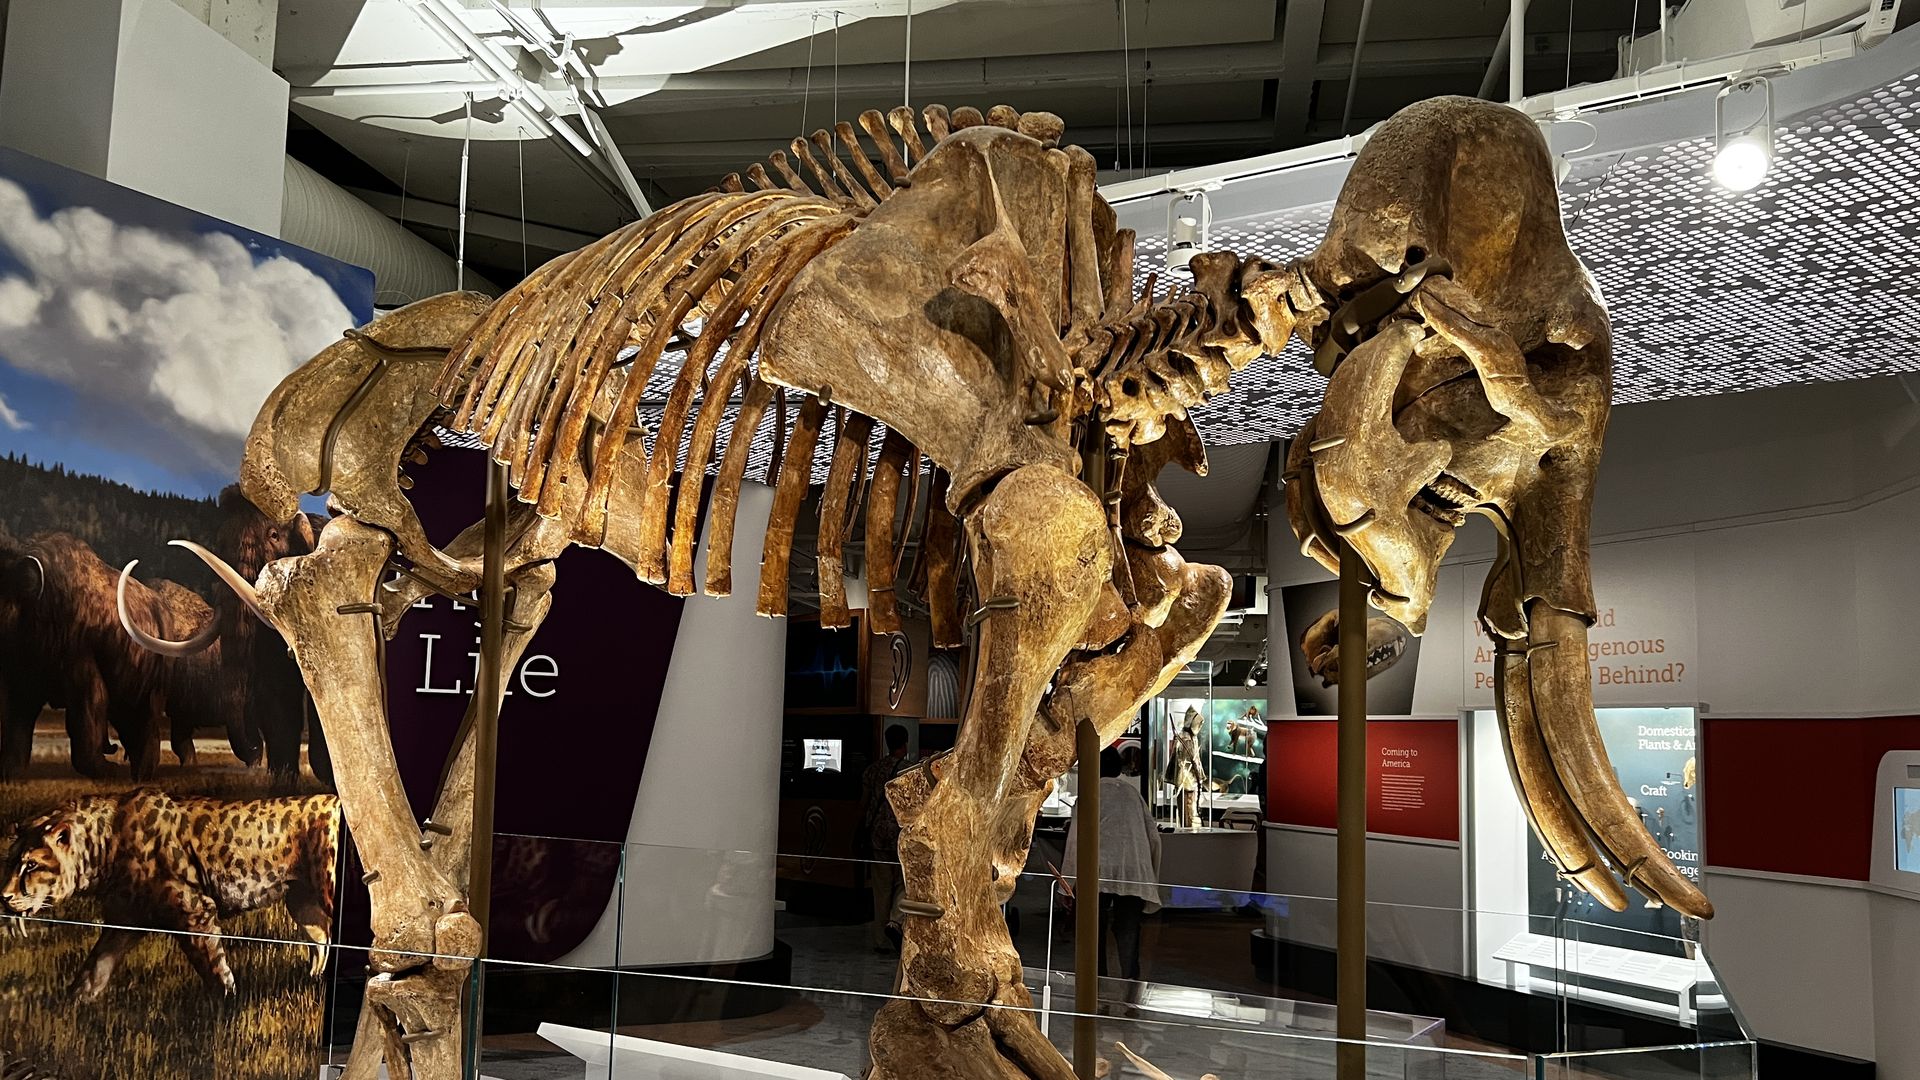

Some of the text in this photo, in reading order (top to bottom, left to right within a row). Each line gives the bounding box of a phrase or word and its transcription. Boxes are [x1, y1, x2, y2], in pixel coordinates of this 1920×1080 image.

[1596, 608, 1616, 628] id
[1588, 638, 1665, 661] genous
[416, 633, 559, 698] Lie
[1598, 662, 1685, 685] Behind?
[1638, 725, 1696, 737] Domestica
[1638, 739, 1671, 751] Plants
[1673, 740, 1682, 750] &
[1381, 747, 1410, 758] Coming
[1381, 759, 1411, 768] America
[1640, 785, 1667, 796] Craft
